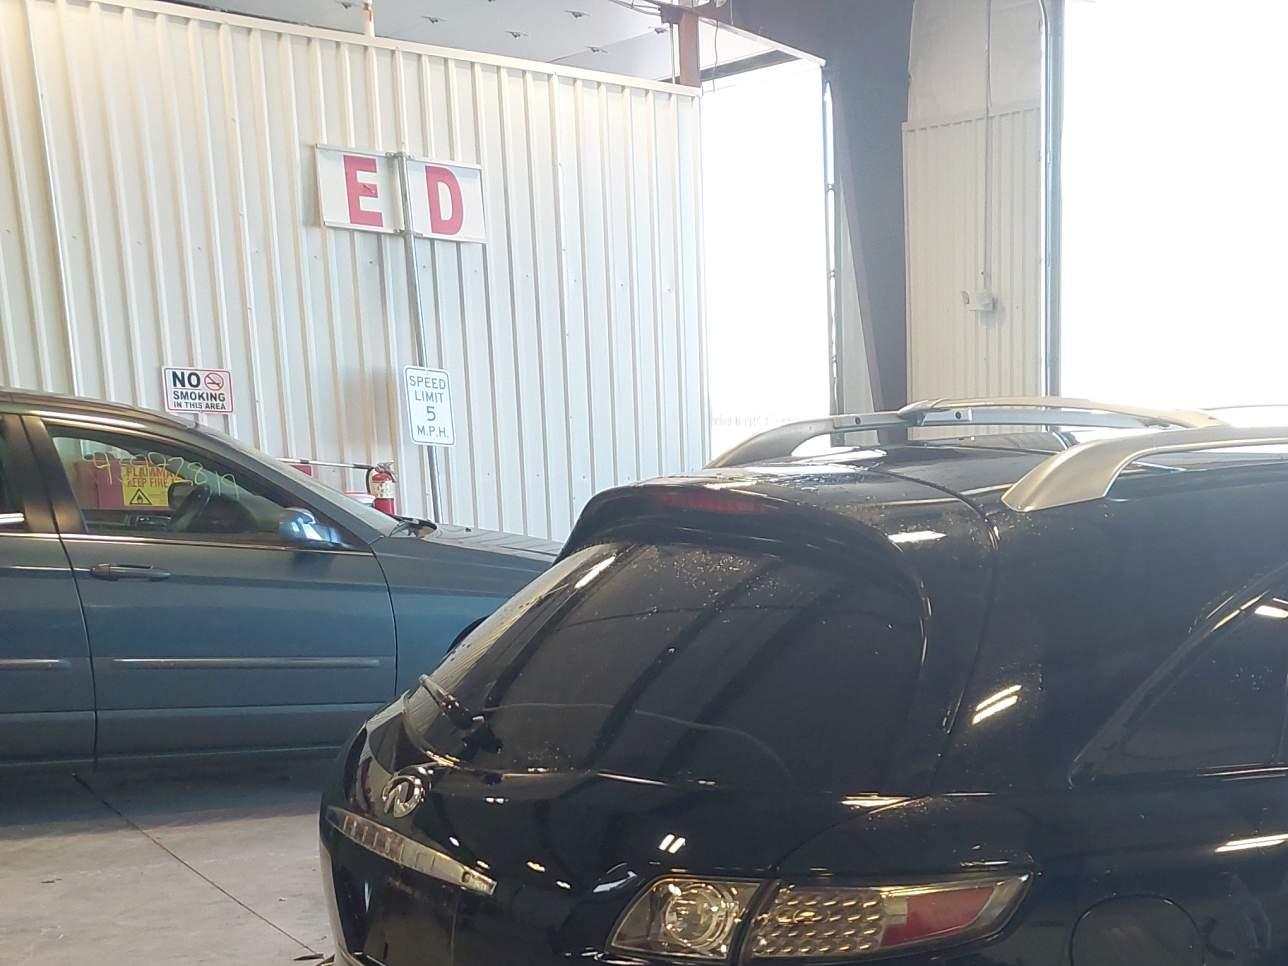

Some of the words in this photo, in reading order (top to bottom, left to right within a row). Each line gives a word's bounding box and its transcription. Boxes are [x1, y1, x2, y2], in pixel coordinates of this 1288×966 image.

[343, 154, 384, 228] E
[424, 165, 464, 236] D
[171, 371, 201, 388] NO
[409, 375, 446, 390] SPEED
[173, 390, 226, 402] SMOKING
[414, 390, 444, 403] LIMIT
[174, 401, 183, 409] IN
[426, 405, 436, 422] 5
[417, 424, 449, 438] M.P.H.
